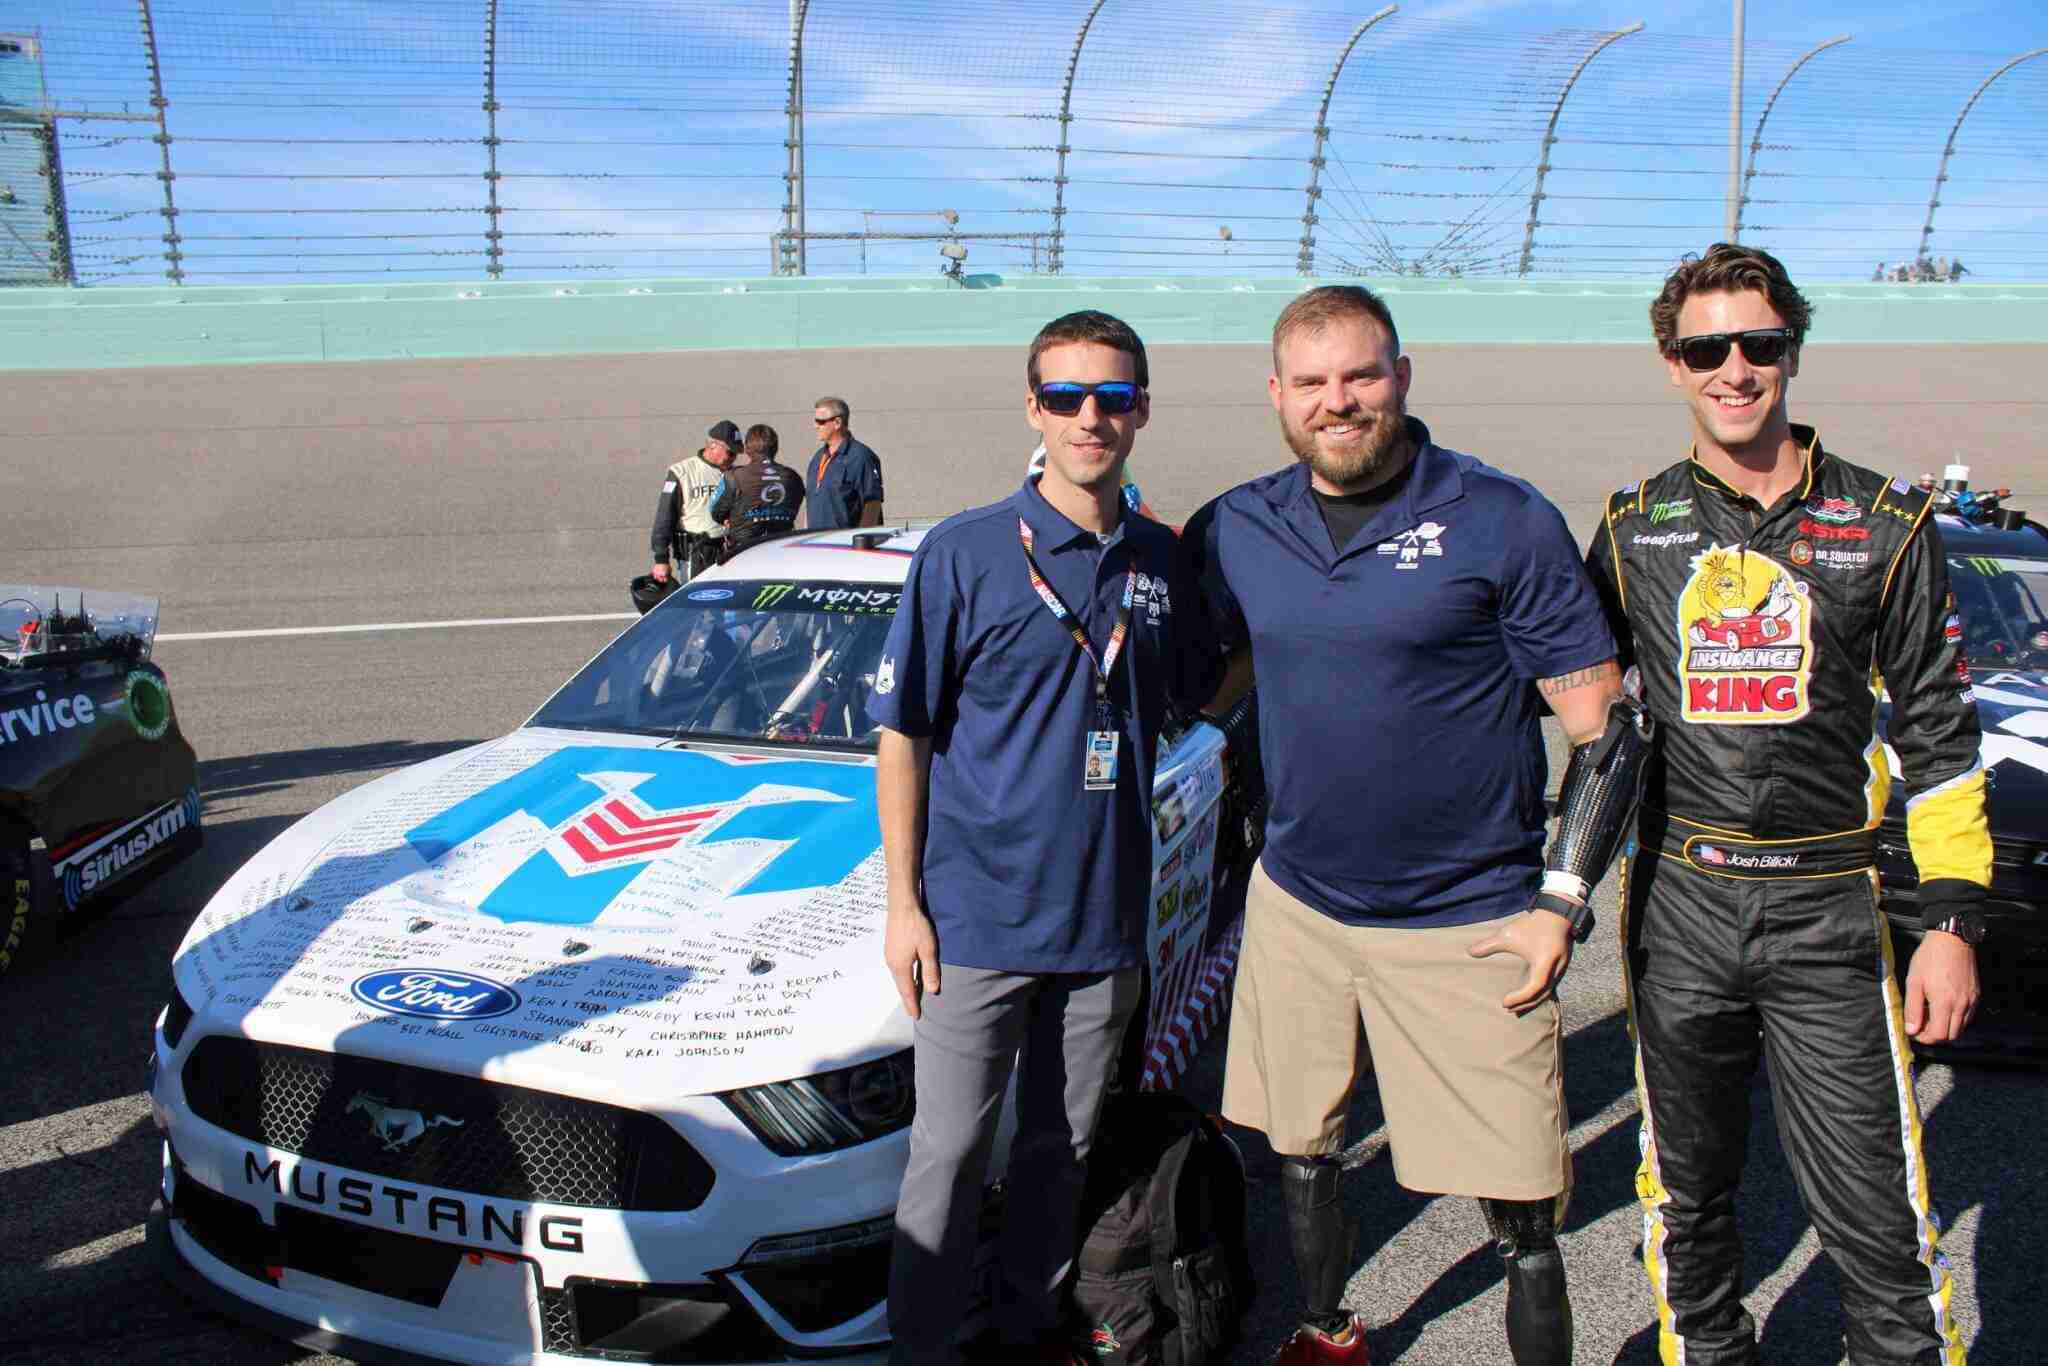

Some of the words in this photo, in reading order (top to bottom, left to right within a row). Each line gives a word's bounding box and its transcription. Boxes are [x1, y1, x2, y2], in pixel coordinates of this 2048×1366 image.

[1633, 532, 1700, 549] GOODYEAR
[1829, 551, 1869, 563] SQUATCH
[1688, 648, 1801, 668] INSURANCE
[1688, 675, 1798, 713] KING
[1726, 853, 1760, 868] Josh
[377, 973, 491, 1013] Ford
[738, 983, 775, 992] DAN
[727, 993, 768, 1005] JOSH
[782, 988, 813, 1000] DAY
[616, 1006, 682, 1023] KENNEDY
[694, 1010, 736, 1022] KEVIN
[744, 1005, 798, 1018] TAYLOR
[594, 1023, 630, 1037] SAY
[650, 1029, 727, 1042] CHRISTOPHER
[674, 1045, 745, 1058] JOHNSON
[245, 1150, 584, 1253] MUSTANG
